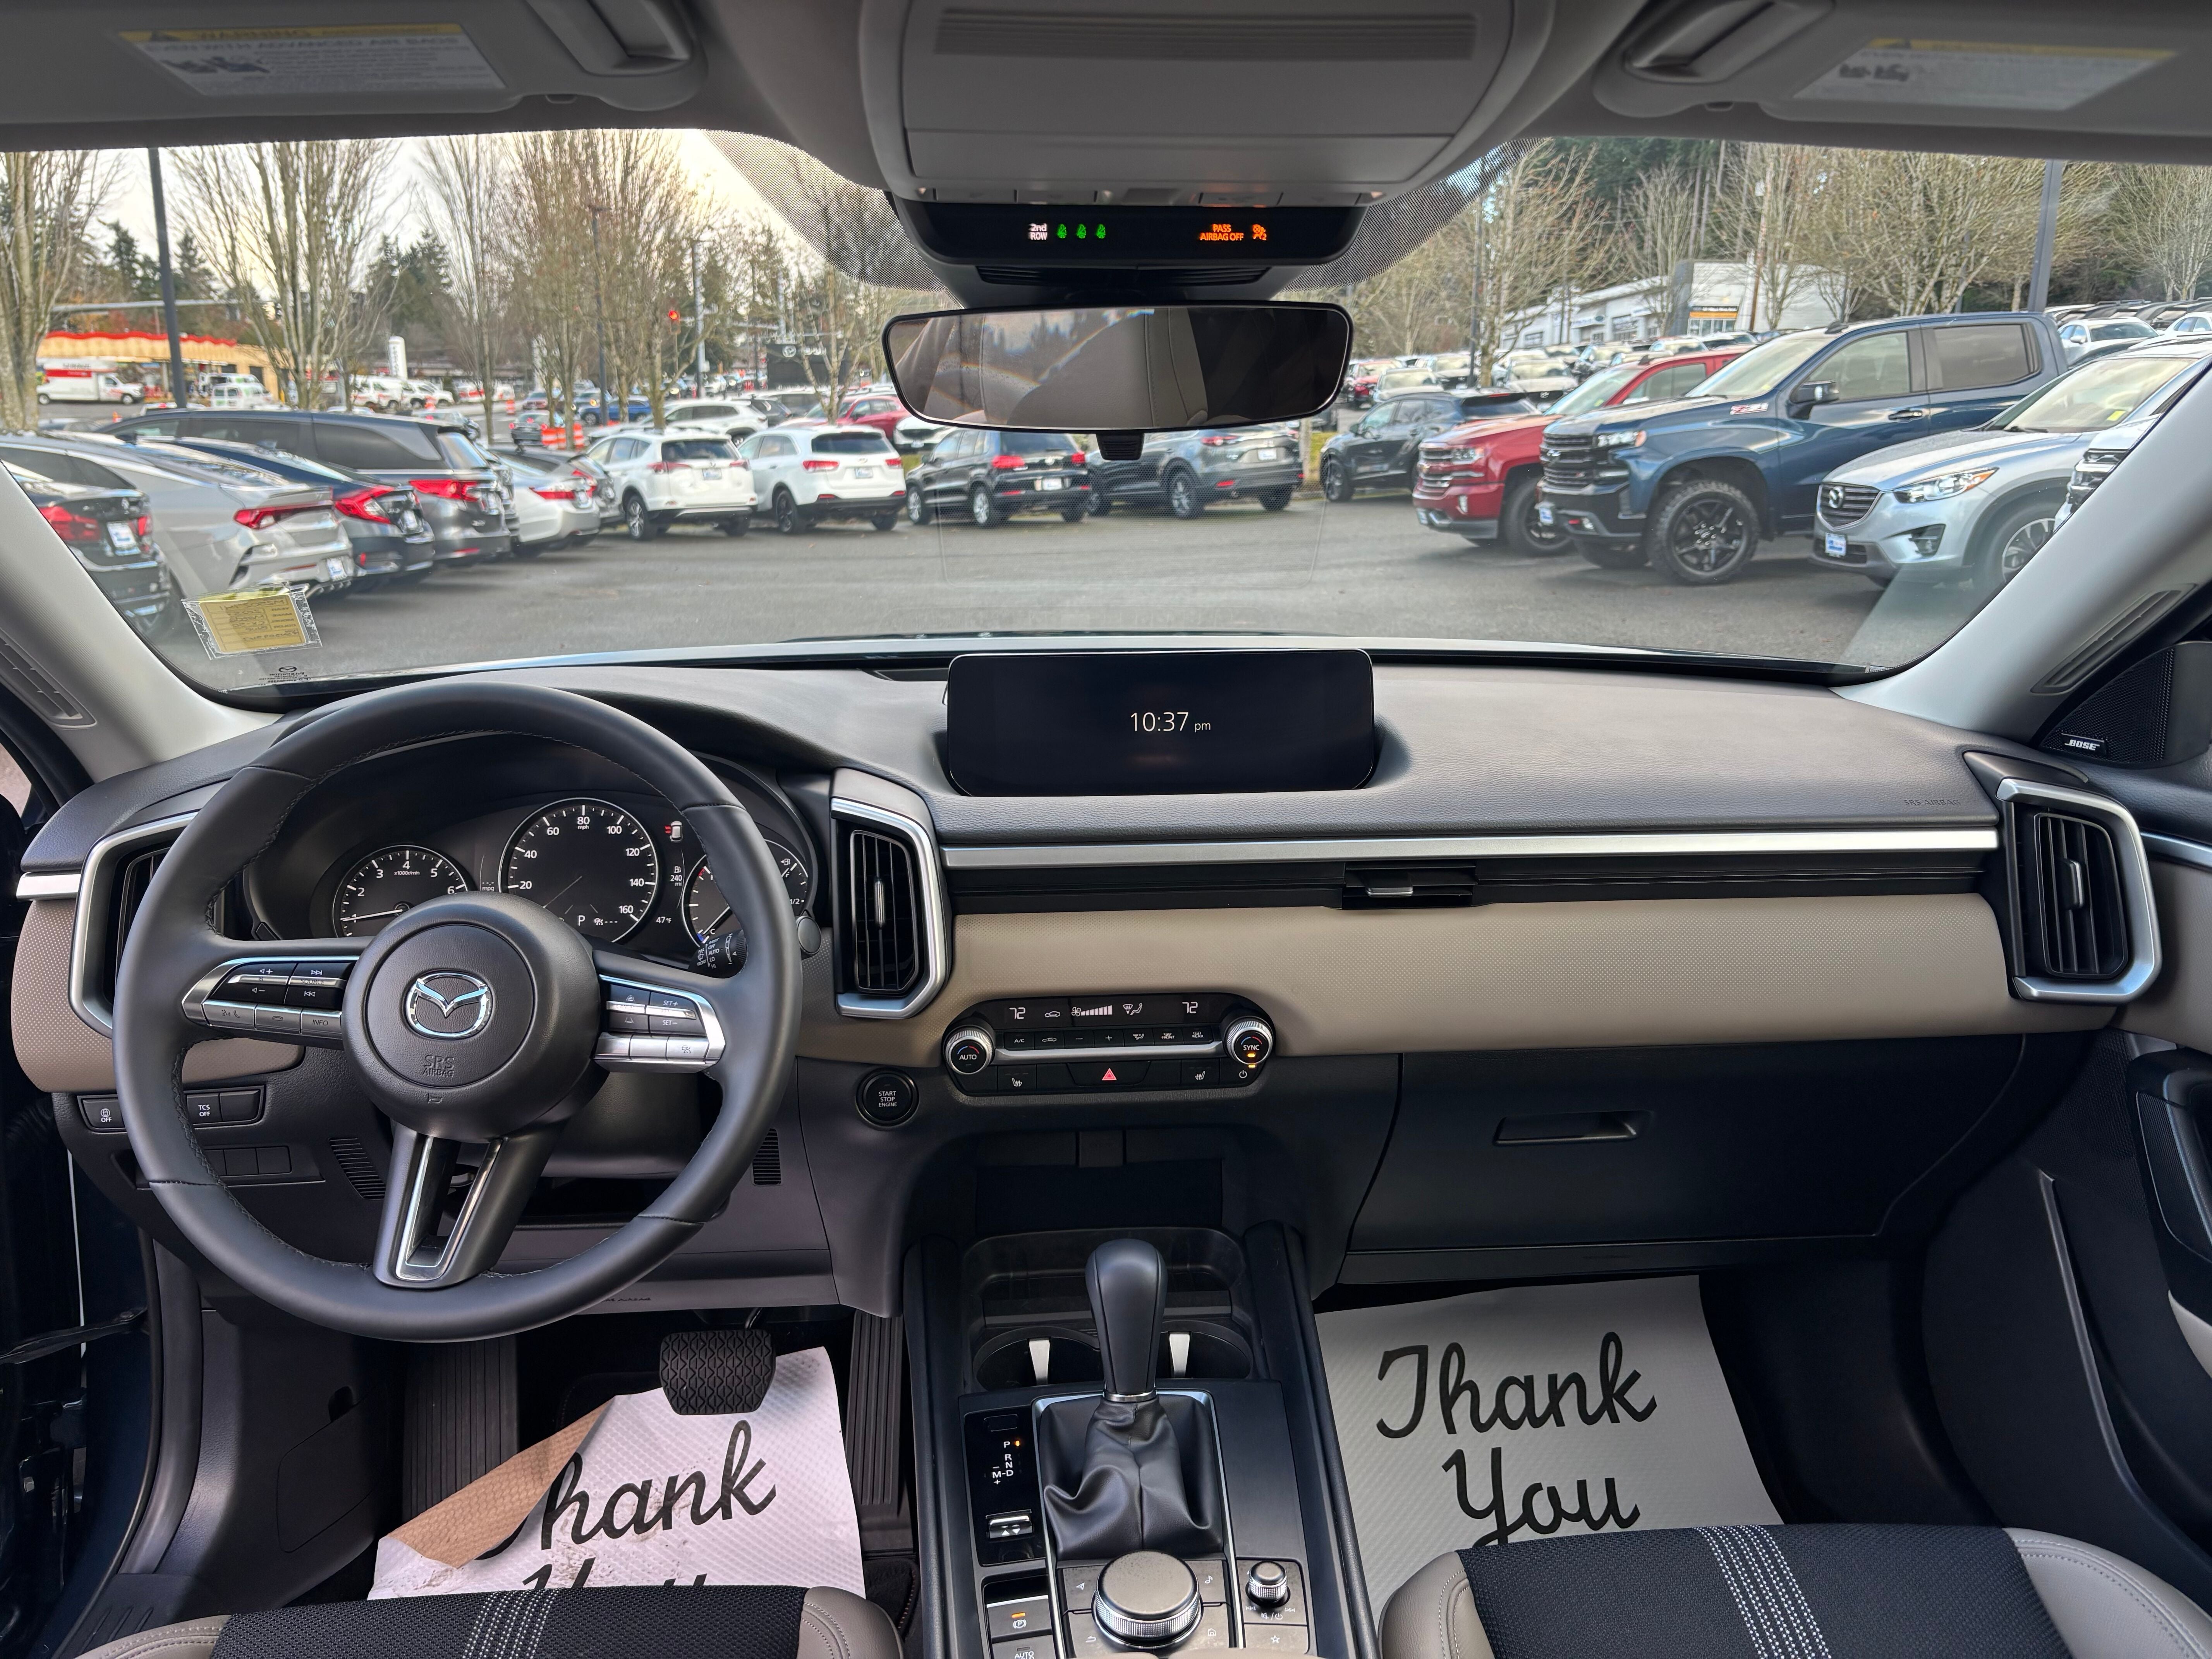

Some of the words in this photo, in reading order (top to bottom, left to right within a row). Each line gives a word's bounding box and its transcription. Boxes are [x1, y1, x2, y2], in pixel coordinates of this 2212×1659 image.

[1029, 223, 1047, 232] 2nd
[1212, 224, 1231, 232] PASS
[1029, 232, 1048, 240] ROW
[1200, 232, 1229, 241] AIRBAG
[1230, 232, 1244, 241] OFF
[1131, 712, 1188, 732] 10:37
[1195, 723, 1211, 733] pm
[2064, 739, 2100, 750] BOSE
[577, 816, 590, 825] 80
[547, 827, 560, 835] 60
[607, 826, 622, 834] 100
[524, 850, 537, 859] 40
[625, 848, 640, 856] 120
[402, 861, 410, 870] 4
[376, 869, 383, 879] 3
[430, 868, 438, 878] 5
[520, 881, 532, 889] 20
[630, 878, 644, 887] 140
[357, 888, 365, 897] 2
[447, 886, 455, 895] 6
[619, 905, 634, 914] 160
[578, 915, 586, 926] P
[1182, 1002, 1198, 1013] 72
[1009, 1007, 1025, 1019] 72
[423, 1054, 455, 1069] SRS
[422, 1068, 454, 1077] AIRBAG
[1376, 1331, 1657, 1439] Thank
[476, 1420, 777, 1561] hank
[1441, 1446, 1641, 1548] You
